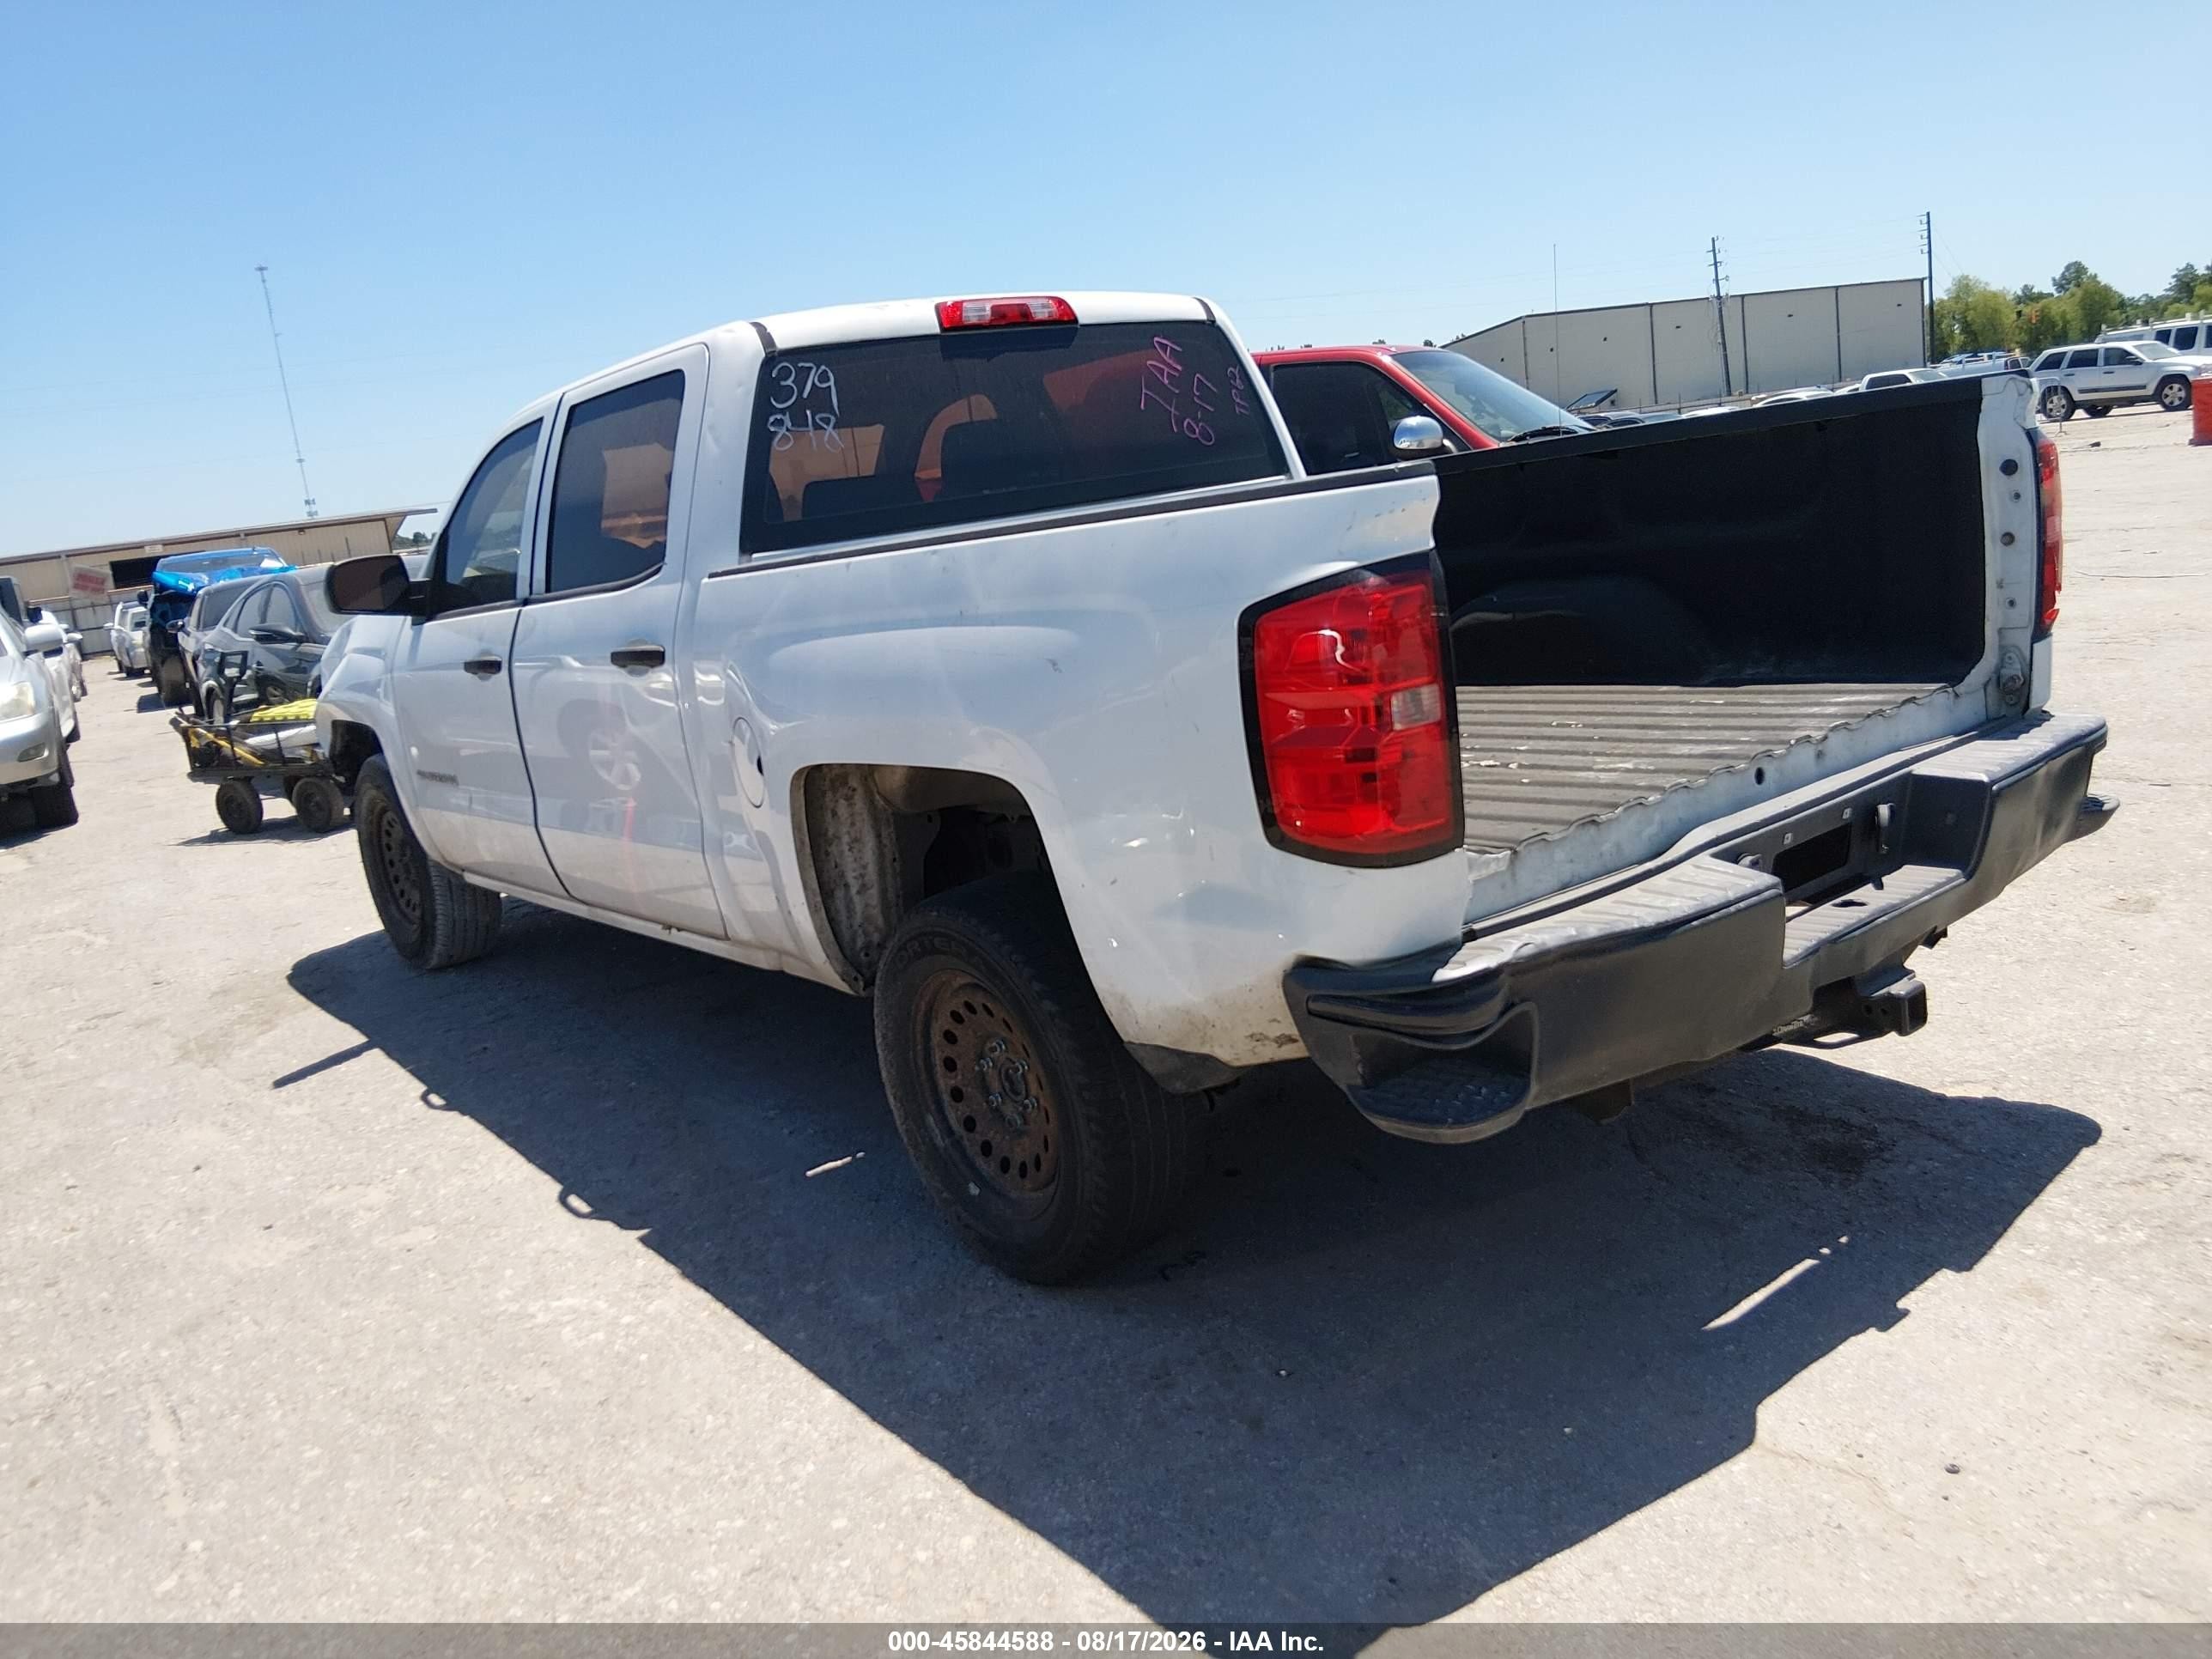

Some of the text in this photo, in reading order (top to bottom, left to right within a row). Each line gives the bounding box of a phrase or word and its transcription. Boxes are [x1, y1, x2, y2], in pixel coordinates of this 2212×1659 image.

[769, 362, 840, 417] 379
[1140, 336, 1182, 433] IAA
[1183, 373, 1217, 446] 8-17
[767, 409, 844, 453] 848
